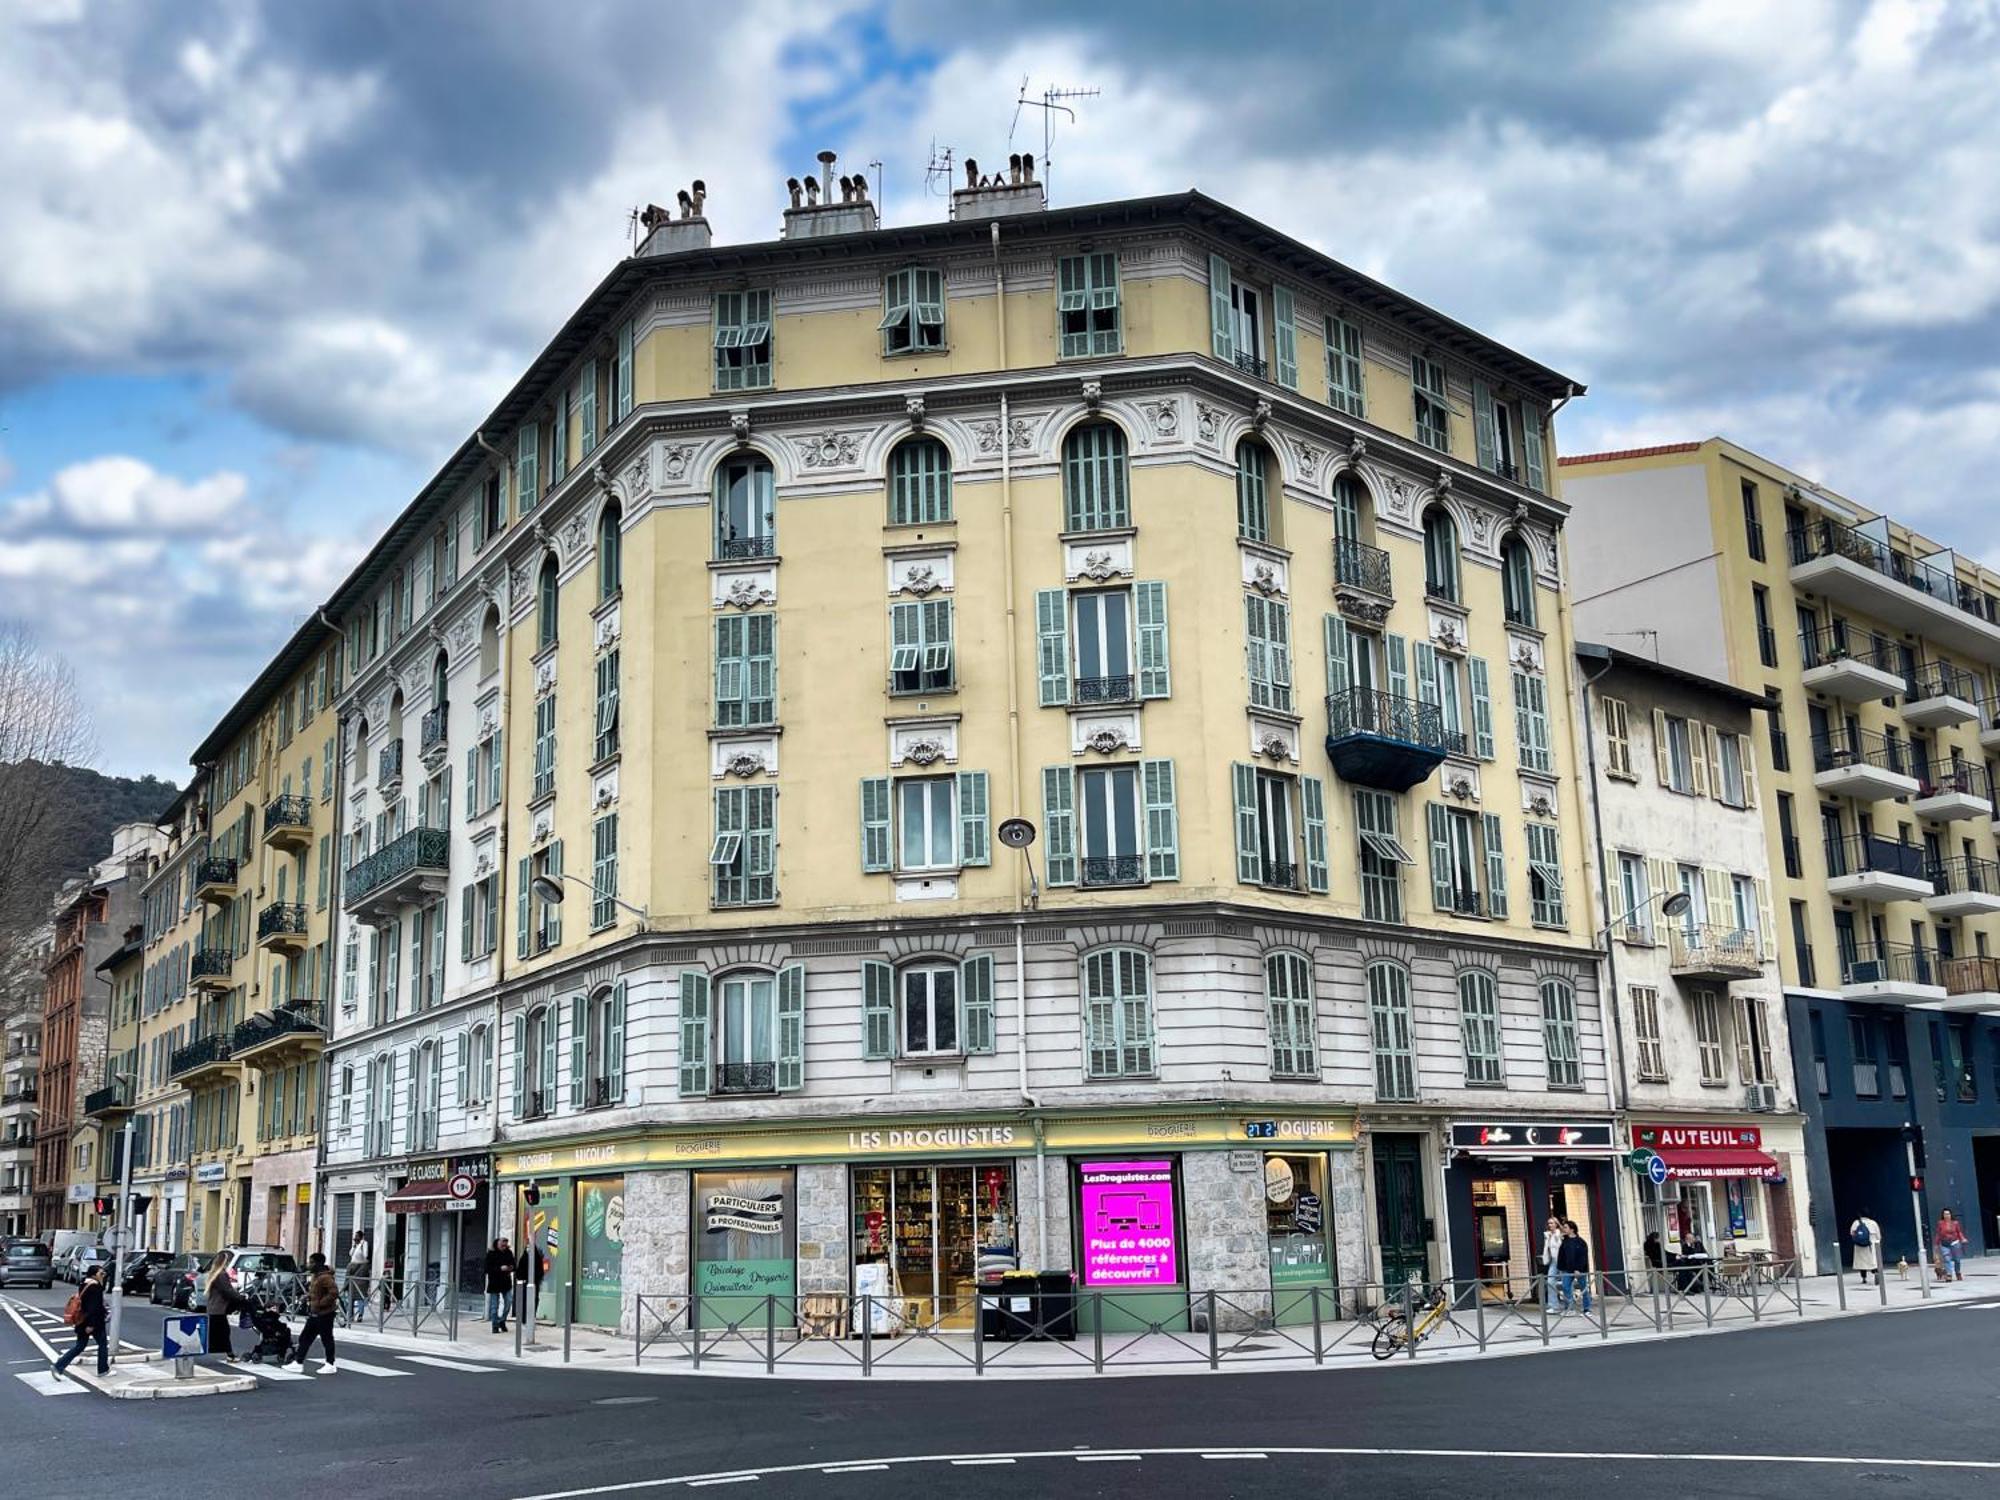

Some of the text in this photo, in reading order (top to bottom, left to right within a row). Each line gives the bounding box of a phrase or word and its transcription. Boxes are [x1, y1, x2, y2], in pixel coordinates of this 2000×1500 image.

[1280, 1121, 1335, 1135] OGUERIE
[849, 1127, 1014, 1149] LES DROGUISTES
[1661, 1130, 1738, 1145] AUTEUIL
[676, 1140, 720, 1153] DROGUERIE
[417, 1163, 445, 1180] CLASSICO
[1676, 1169, 1700, 1177] SPORTS
[1701, 1168, 1713, 1176] BAR
[1715, 1168, 1745, 1176] BRASSERIE
[1749, 1167, 1763, 1176] CAFÉ
[1083, 1173, 1171, 1184] LesDroguistes.com
[713, 1197, 777, 1212] PARTICULIERS
[718, 1218, 779, 1231] PROFESSIONNELS
[1090, 1238, 1171, 1249] Plus de 4000
[1091, 1253, 1168, 1264] références à
[1091, 1269, 1153, 1279] découvrir
